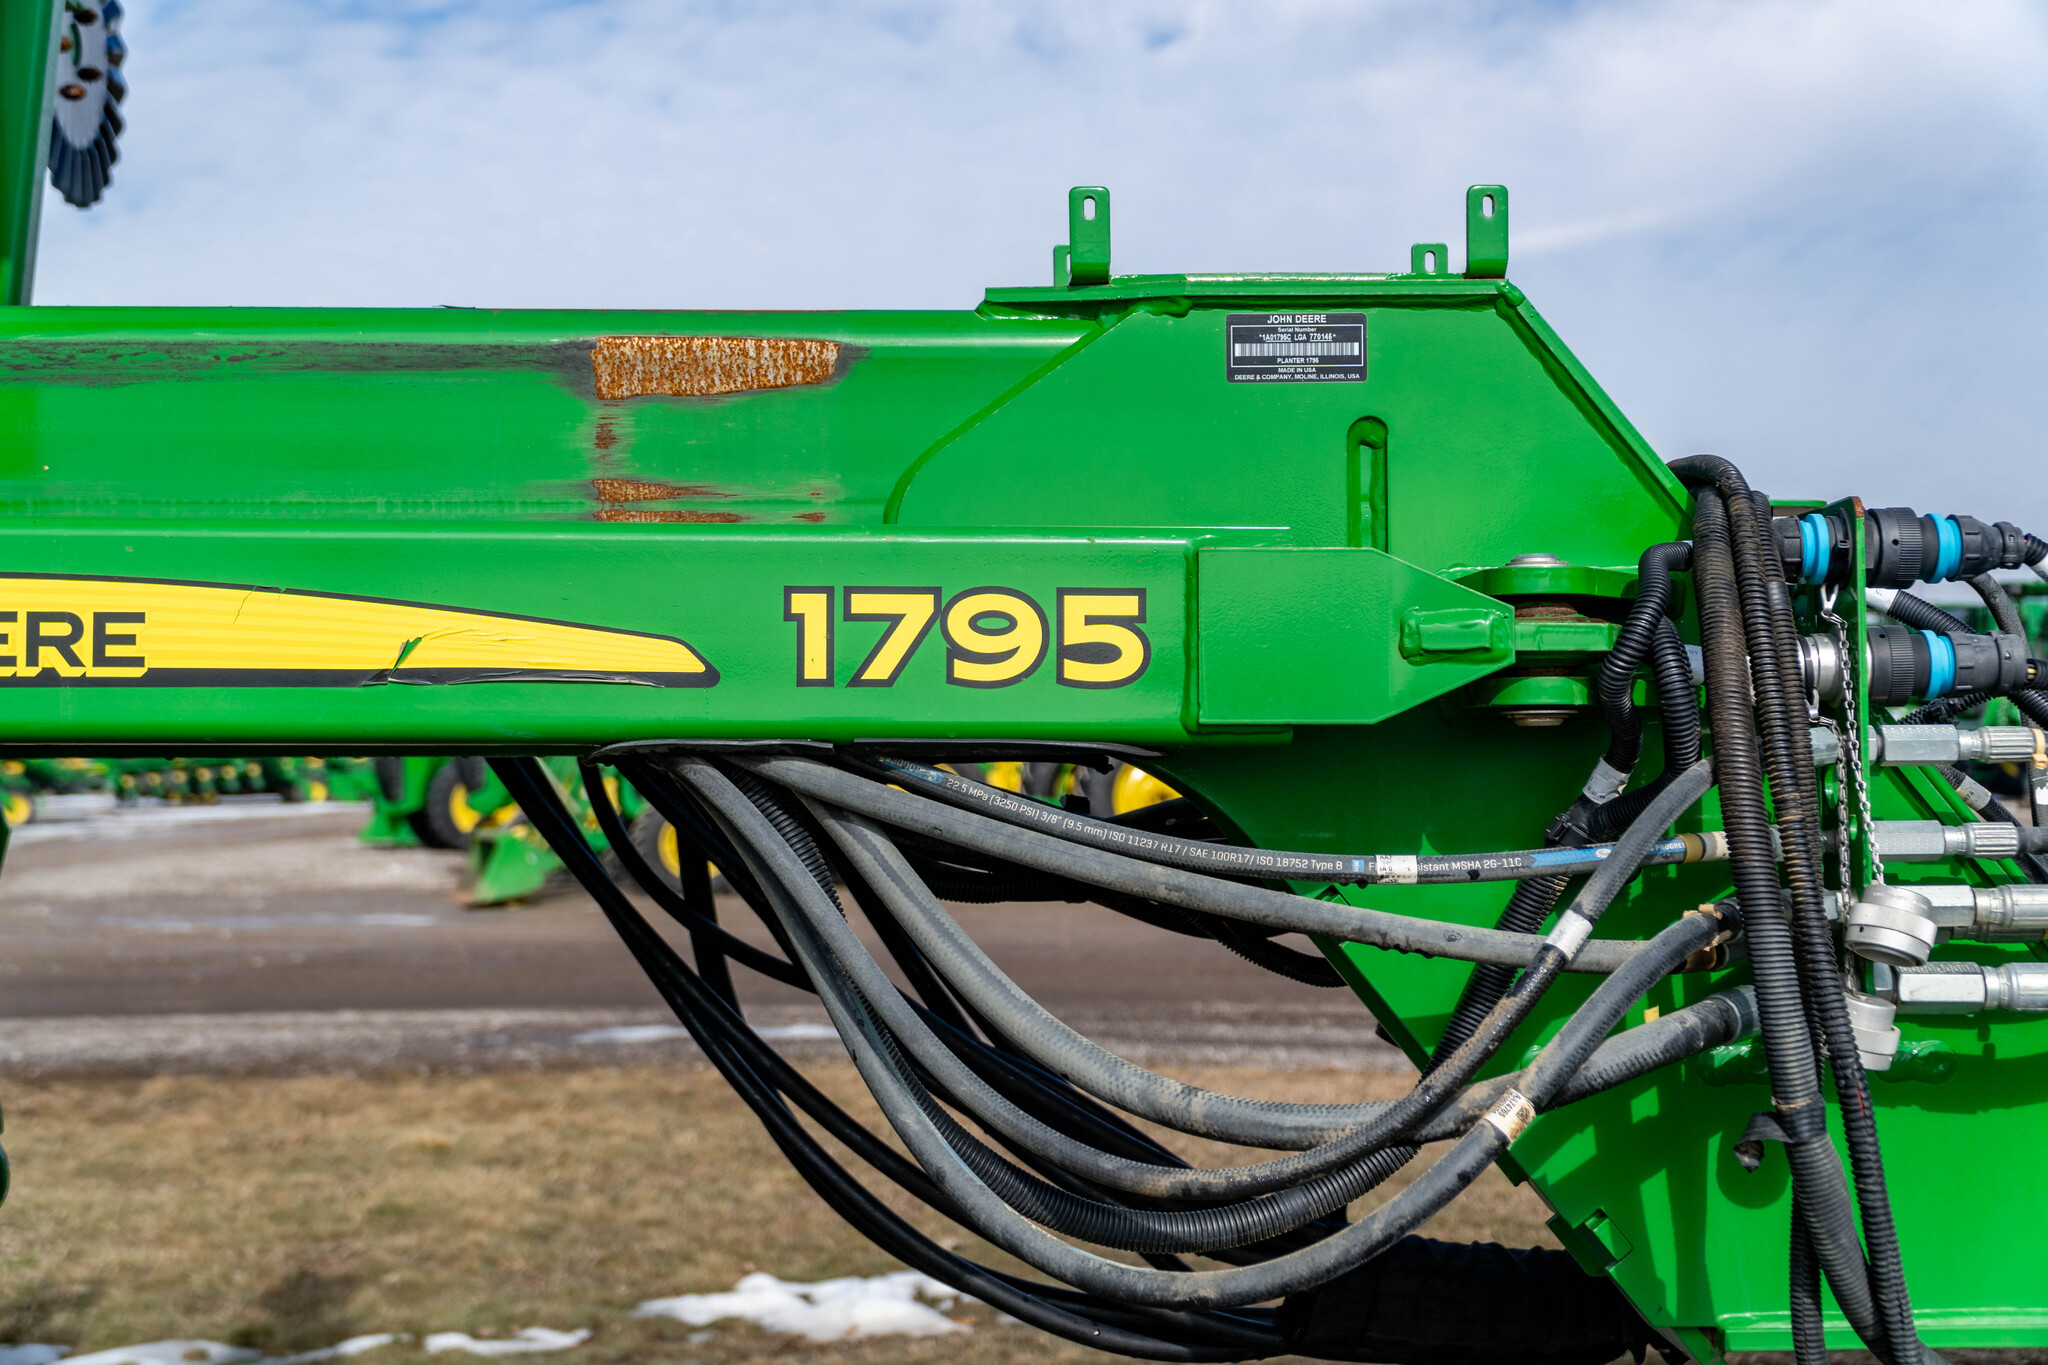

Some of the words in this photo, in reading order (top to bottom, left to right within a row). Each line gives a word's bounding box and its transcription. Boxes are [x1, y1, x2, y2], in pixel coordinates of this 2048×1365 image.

[1267, 315, 1292, 323] JOHN
[1295, 315, 1327, 323] DEERE
[783, 585, 1151, 689] 1795
[946, 778, 966, 793] 22.5
[968, 786, 988, 801] MPa
[1019, 804, 1040, 820] PSI)
[1083, 825, 1108, 840] mm)
[1108, 830, 1126, 843] ISO
[1127, 835, 1159, 850] 11237
[1160, 843, 1181, 854] R17
[1189, 847, 1209, 858] SAE
[1256, 855, 1273, 866] ISO
[1276, 857, 1308, 869] 18752
[1310, 859, 1334, 872] Type
[1336, 861, 1343, 870] B
[1451, 859, 1482, 871] MSHA
